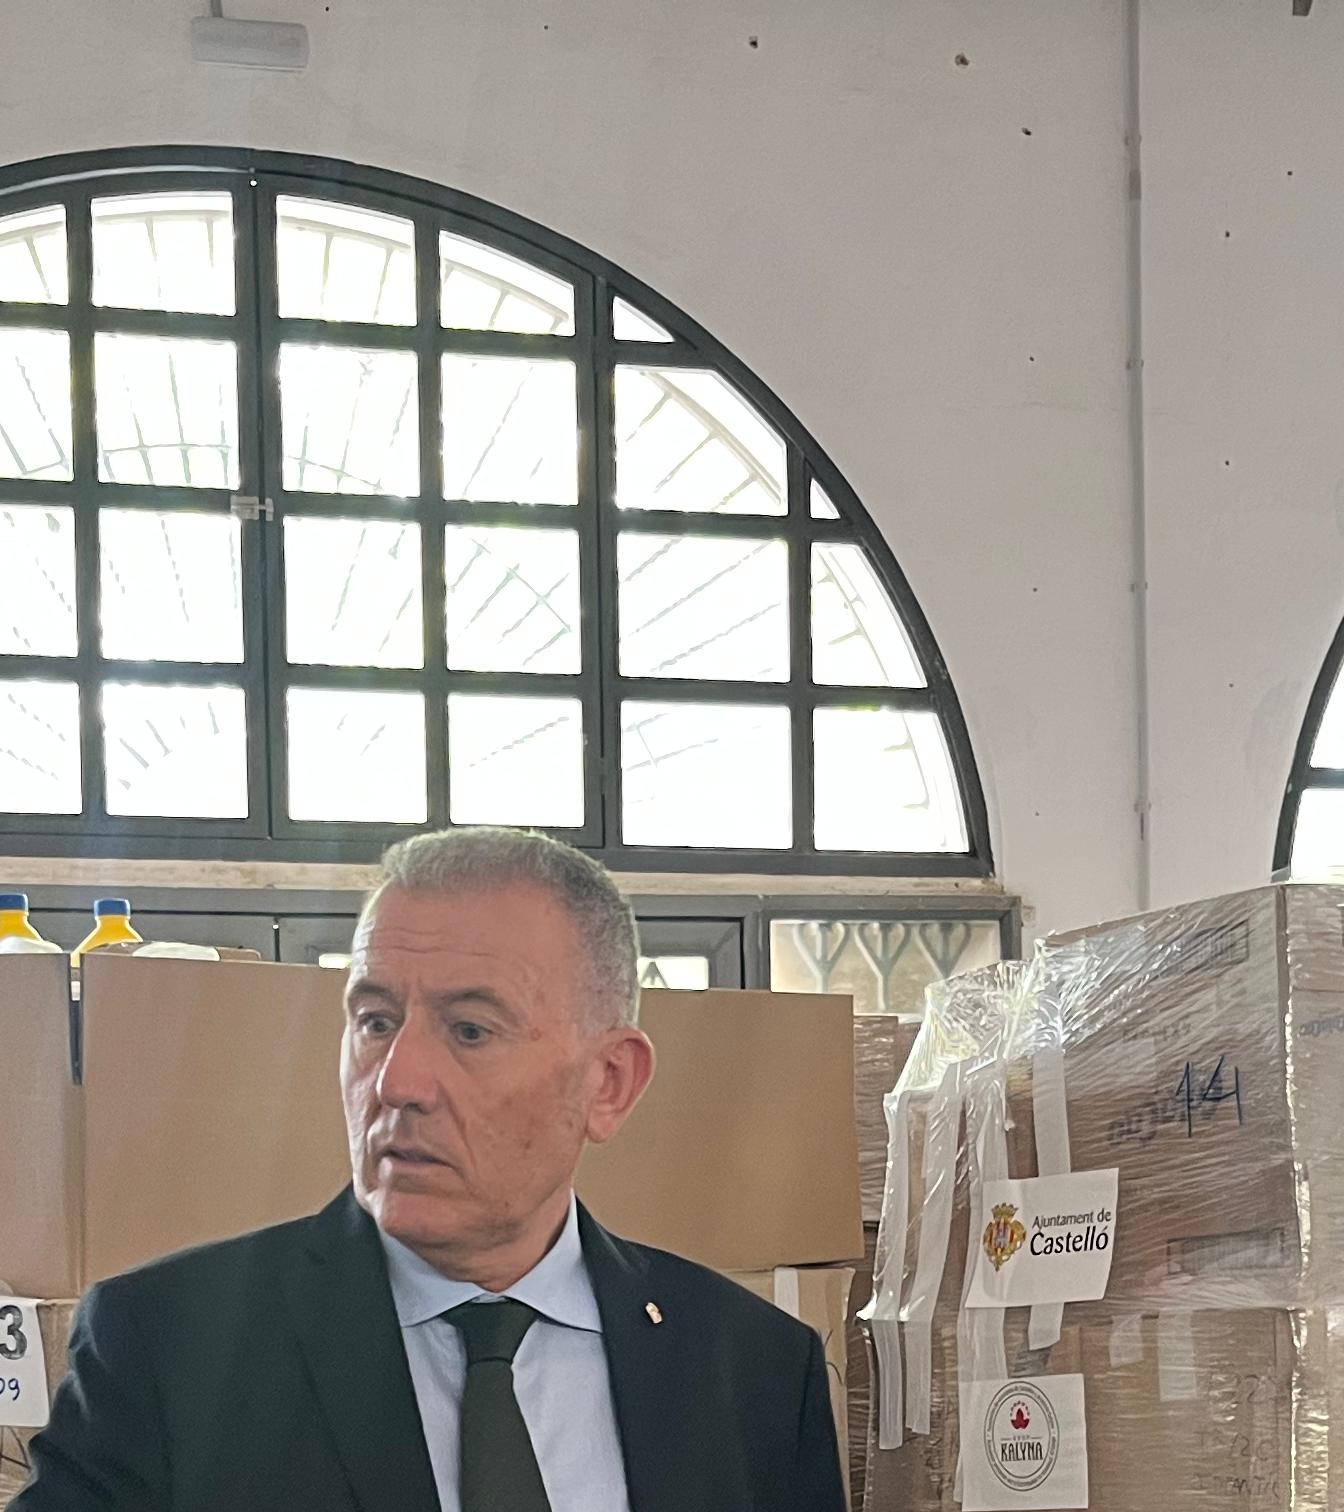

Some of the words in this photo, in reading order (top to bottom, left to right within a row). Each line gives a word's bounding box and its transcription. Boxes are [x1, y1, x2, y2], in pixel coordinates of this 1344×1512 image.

[1175, 1055, 1243, 1138] 14
[1031, 1212, 1094, 1231] Ajuntament
[1097, 1208, 1112, 1223] de
[1030, 1226, 1109, 1256] Castelló
